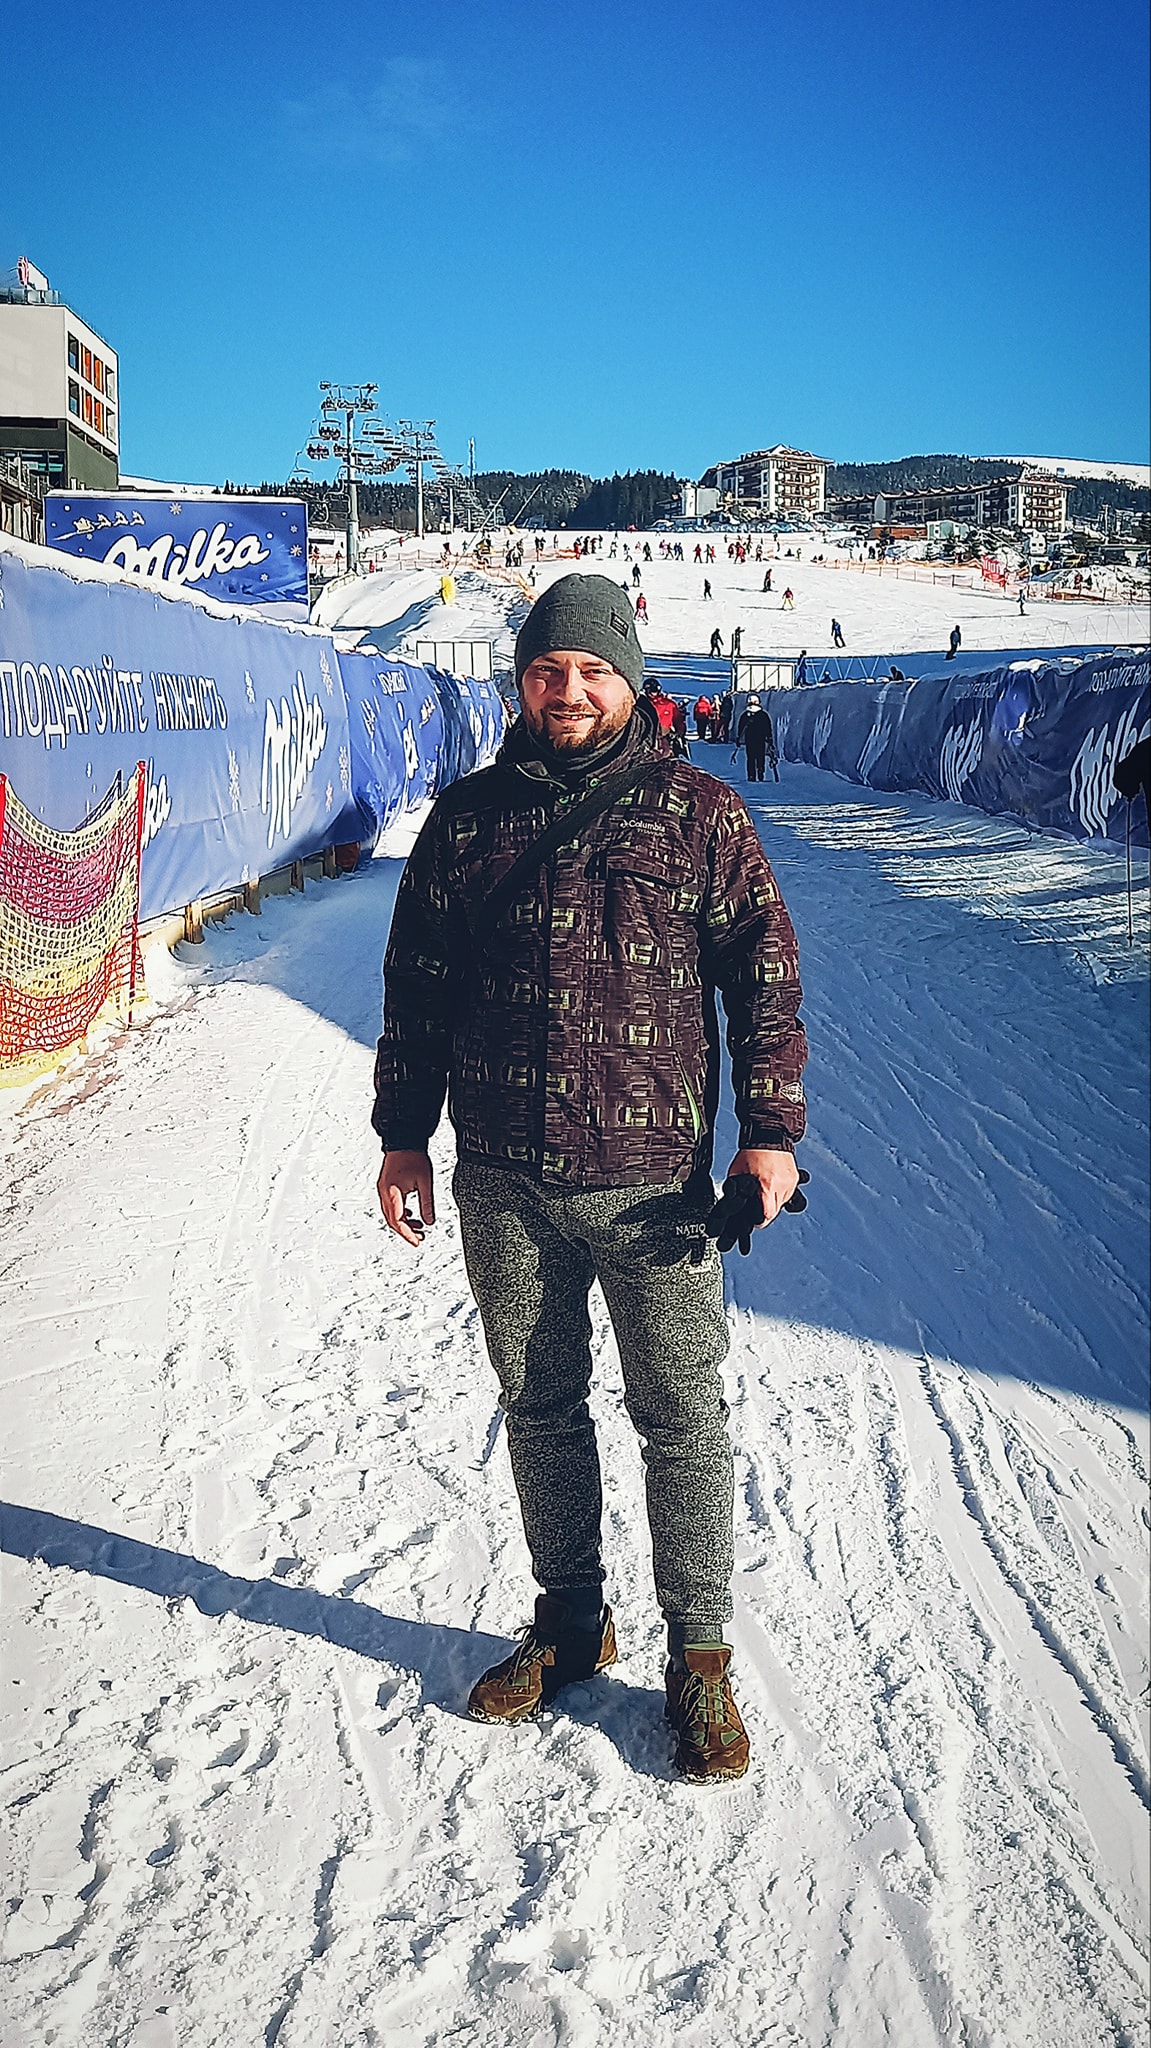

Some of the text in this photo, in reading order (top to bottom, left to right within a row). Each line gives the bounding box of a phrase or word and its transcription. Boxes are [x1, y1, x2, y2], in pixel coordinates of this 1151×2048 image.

[103, 522, 270, 584] Milka
[0, 654, 228, 750] ПОДАРУЙТЕ НІЖНІСТЬ
[261, 669, 328, 850] Milka
[1069, 697, 1150, 839] Milk
[629, 820, 666, 832] Columbia
